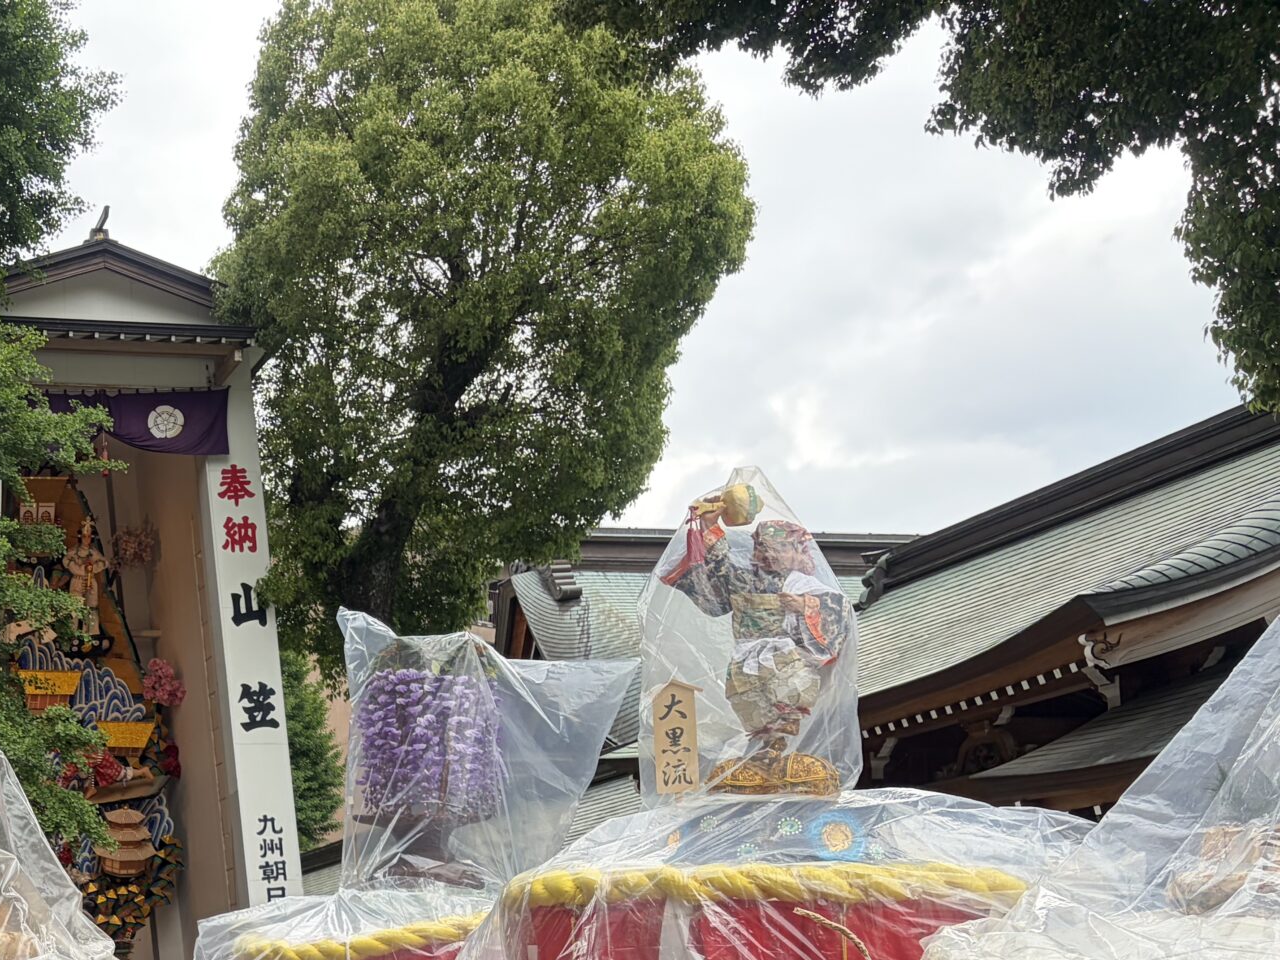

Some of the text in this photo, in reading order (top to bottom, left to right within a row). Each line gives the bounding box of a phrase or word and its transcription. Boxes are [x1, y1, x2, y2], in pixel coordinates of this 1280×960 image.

[217, 463, 258, 553] 奉納
[230, 582, 280, 733] 山笠
[658, 693, 694, 787] 大黒流
